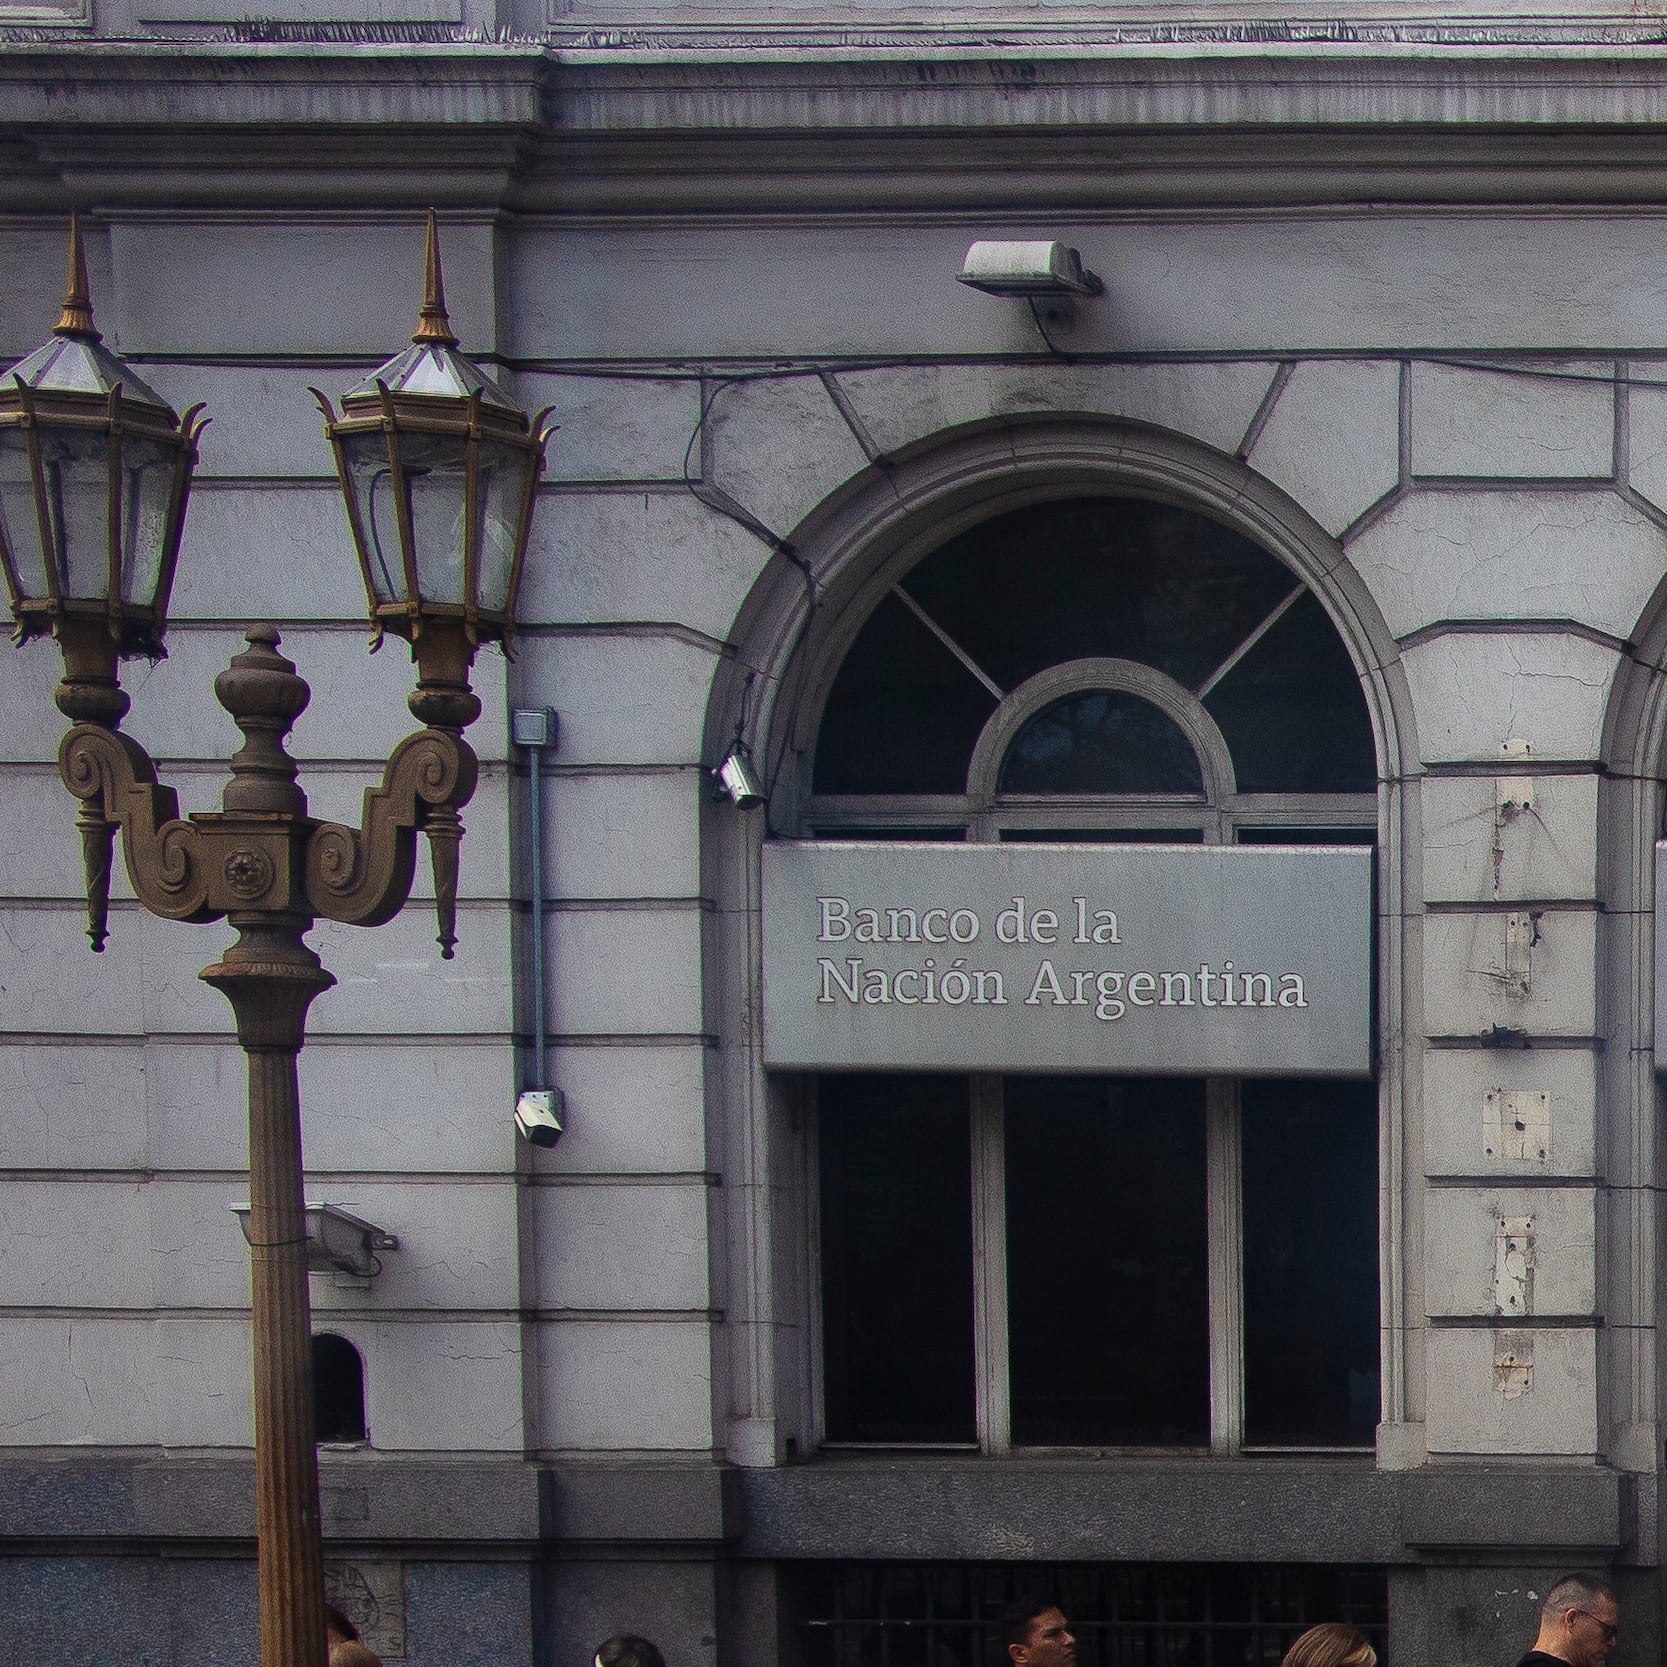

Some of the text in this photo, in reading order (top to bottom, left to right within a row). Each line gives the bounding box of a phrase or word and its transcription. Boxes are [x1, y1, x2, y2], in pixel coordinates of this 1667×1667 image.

[817, 896, 1121, 944] Banco de la
[817, 957, 1308, 1021] Nación Argentina
